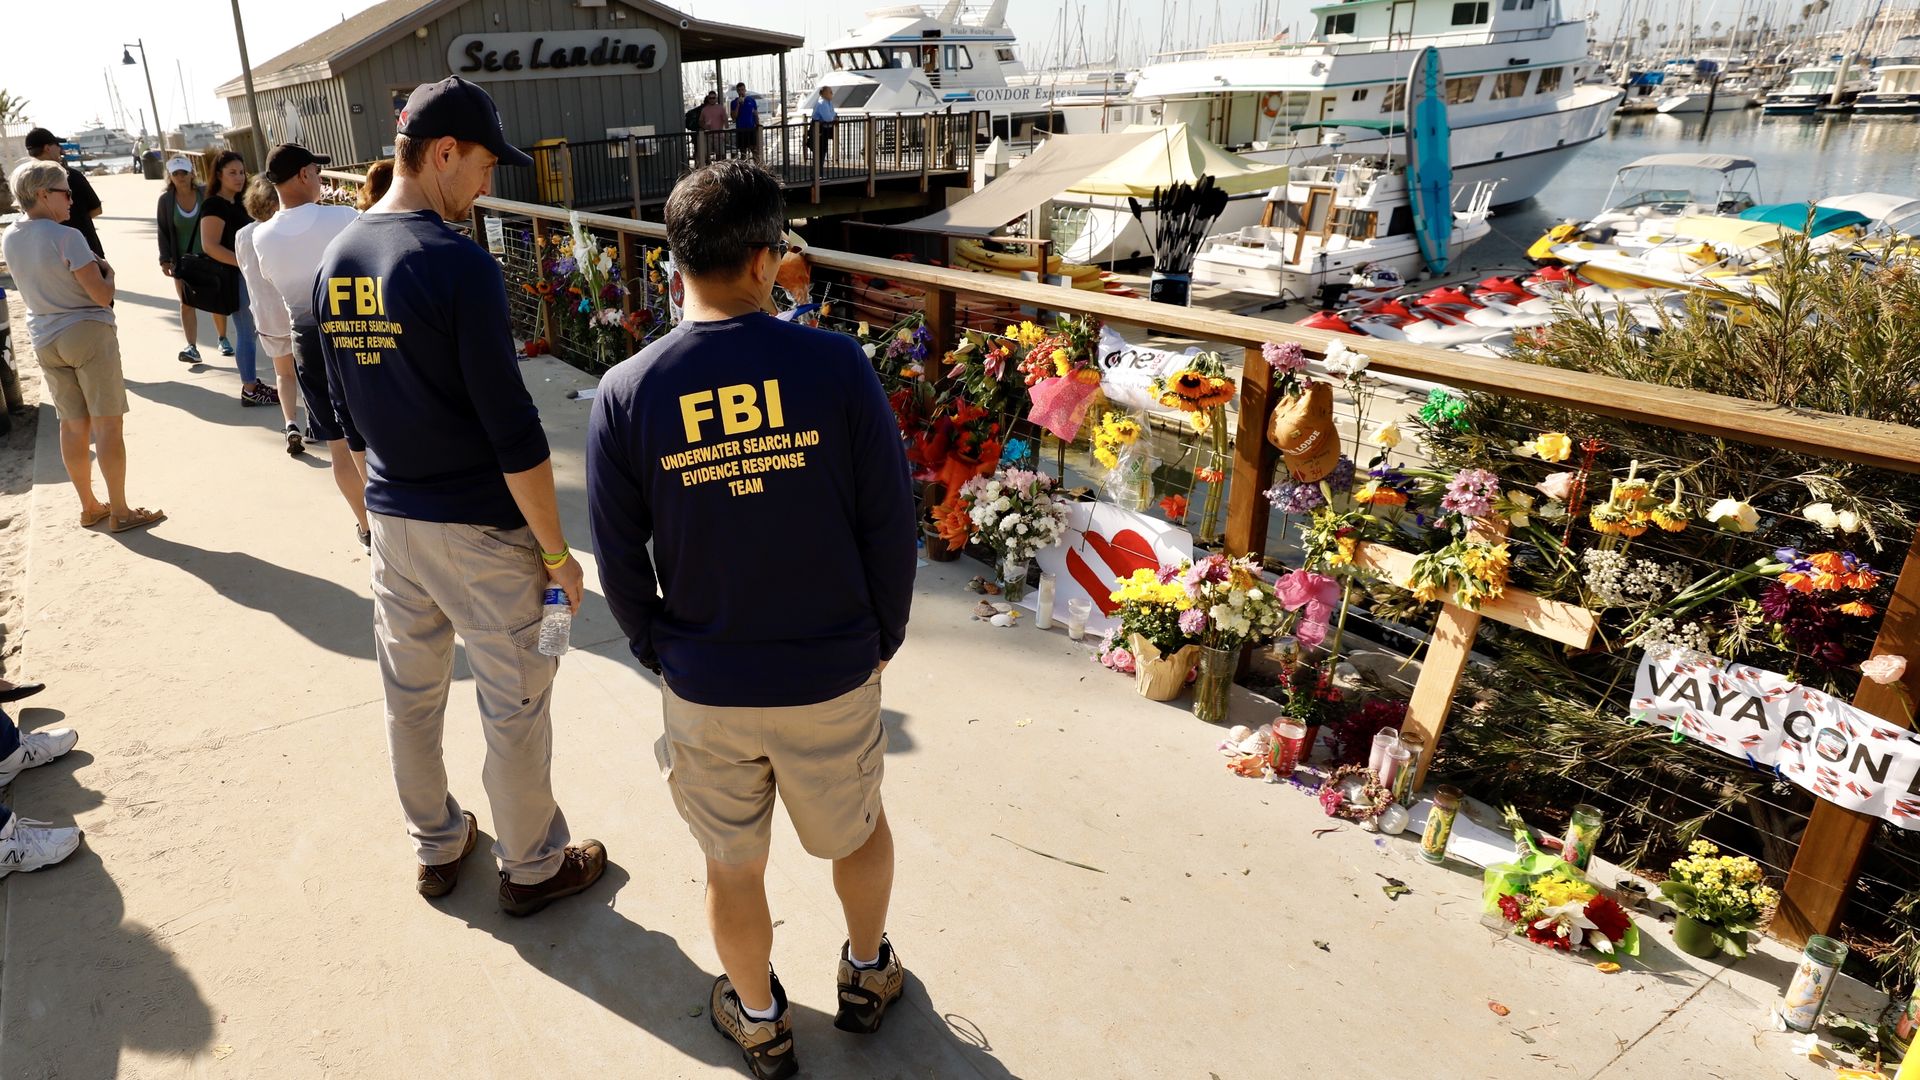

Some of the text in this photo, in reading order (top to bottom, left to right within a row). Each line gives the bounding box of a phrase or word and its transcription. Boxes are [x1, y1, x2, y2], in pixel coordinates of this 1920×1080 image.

[460, 36, 656, 72] Sea Landing
[976, 87, 1077, 102] CONDOR Express
[328, 276, 385, 315] FBI
[332, 336, 365, 349] VIDENCE
[355, 351, 381, 365] TEAM
[679, 379, 785, 443] FBI
[660, 430, 819, 471] UNDERWATER SEARCH AND
[1295, 430, 1321, 452] LODGE
[681, 452, 806, 487] EVIDENCE RESPONSE
[728, 477, 764, 497] TEAM
[1648, 664, 1769, 731] VAYA
[1782, 711, 1893, 784] CON
